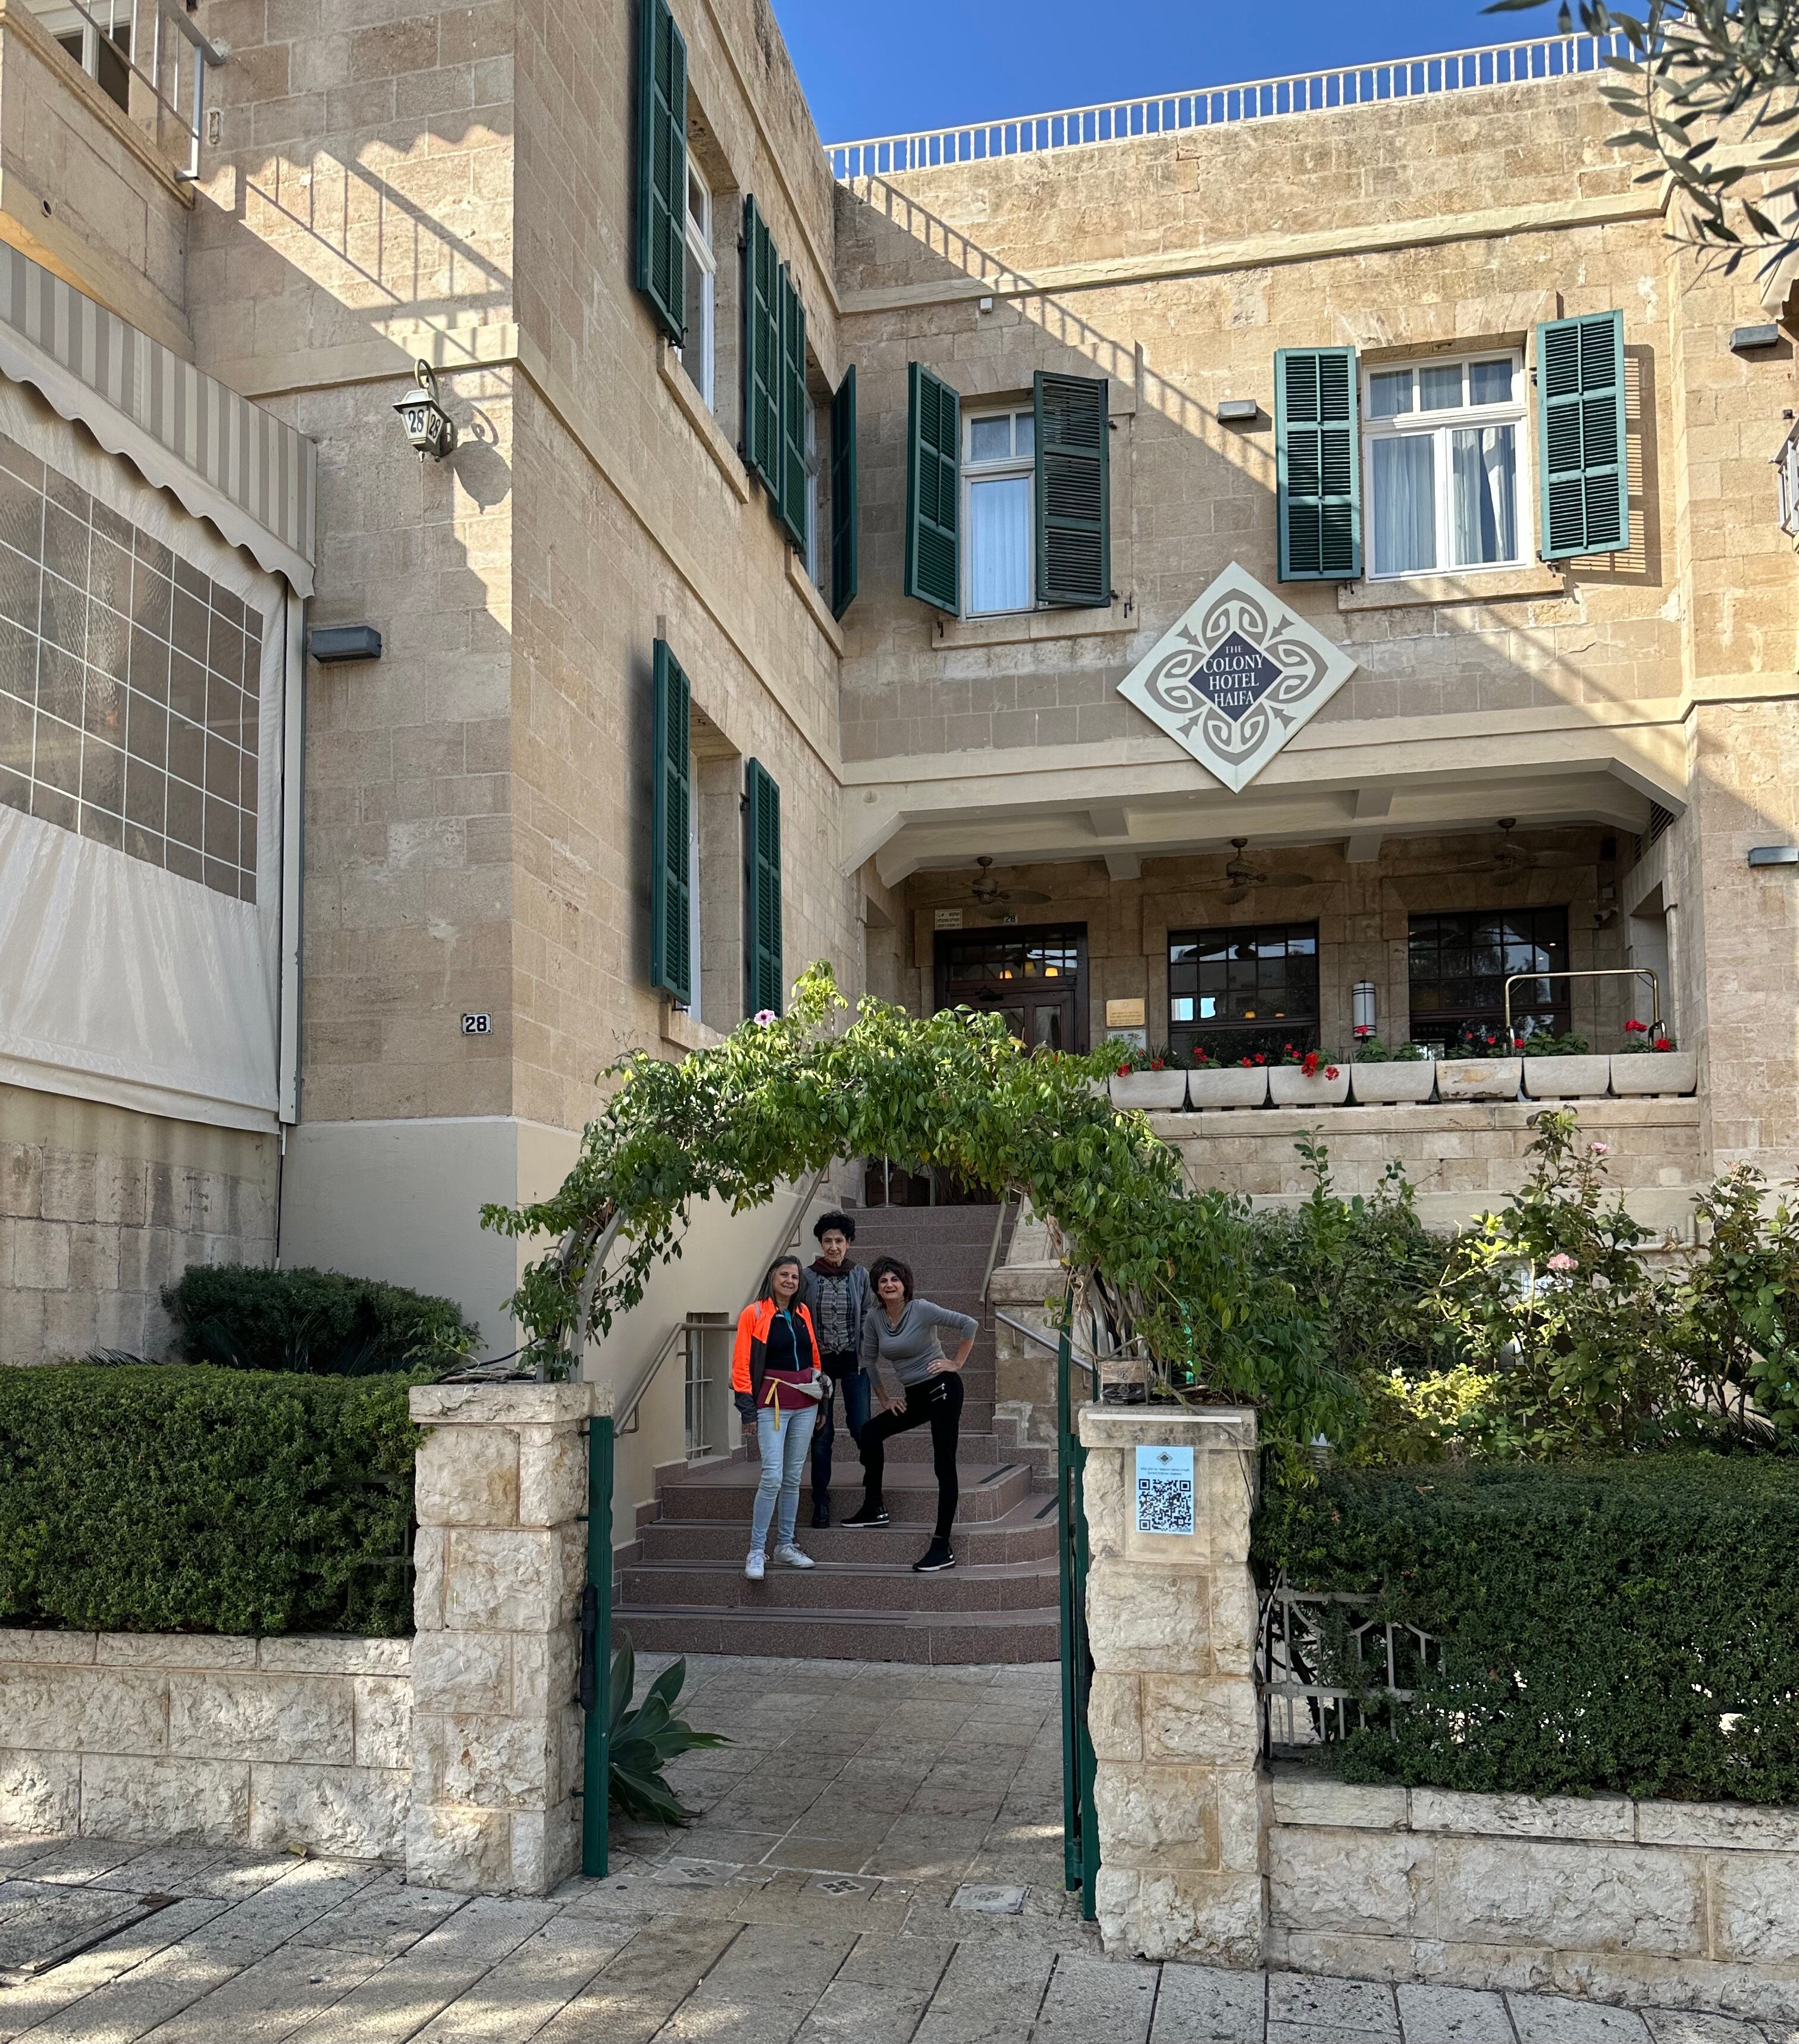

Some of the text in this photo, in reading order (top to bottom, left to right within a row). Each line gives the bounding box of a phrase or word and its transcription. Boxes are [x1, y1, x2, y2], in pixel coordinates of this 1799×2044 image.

[408, 409, 424, 433] 28
[428, 414, 441, 439] 28
[1226, 644, 1243, 654] THE
[1203, 654, 1264, 674] COLONY
[1209, 672, 1259, 691] HOTEL
[1214, 690, 1255, 707] HAIFA
[1005, 915, 1016, 923] 28
[465, 1015, 487, 1033] 28
